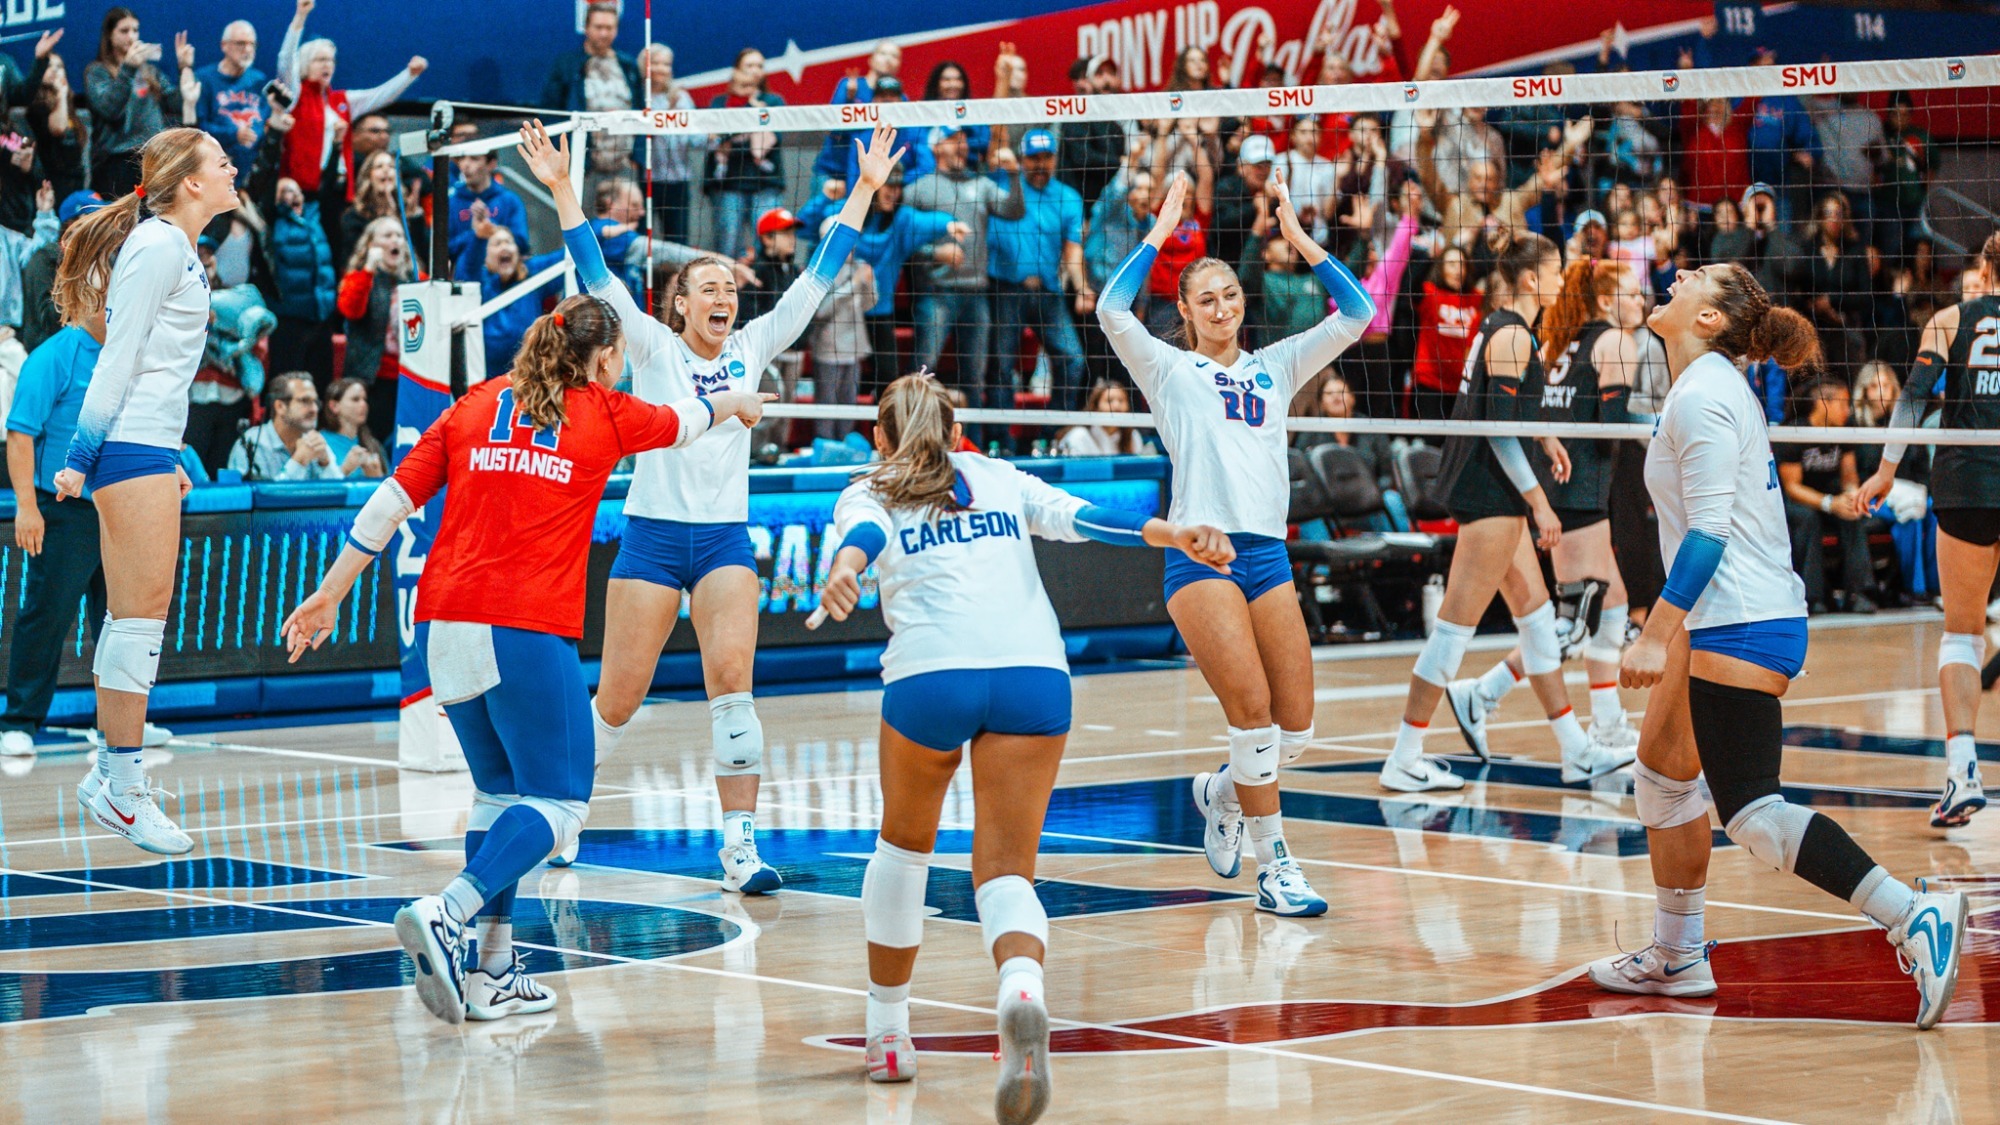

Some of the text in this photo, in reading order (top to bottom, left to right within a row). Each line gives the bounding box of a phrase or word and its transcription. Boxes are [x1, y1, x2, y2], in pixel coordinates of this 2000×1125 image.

[1724, 7, 1755, 36] 113
[1854, 12, 1886, 41] 114
[1513, 77, 1562, 97] SMU
[1782, 65, 1837, 87] SMU
[1045, 97, 1087, 116] SMU
[1267, 89, 1314, 107] SMU
[654, 112, 689, 128] SMU
[842, 105, 879, 123] SMU
[1218, 390, 1266, 427] 20
[469, 447, 573, 484] MUSTANGS
[899, 511, 1021, 555] CARLSON
